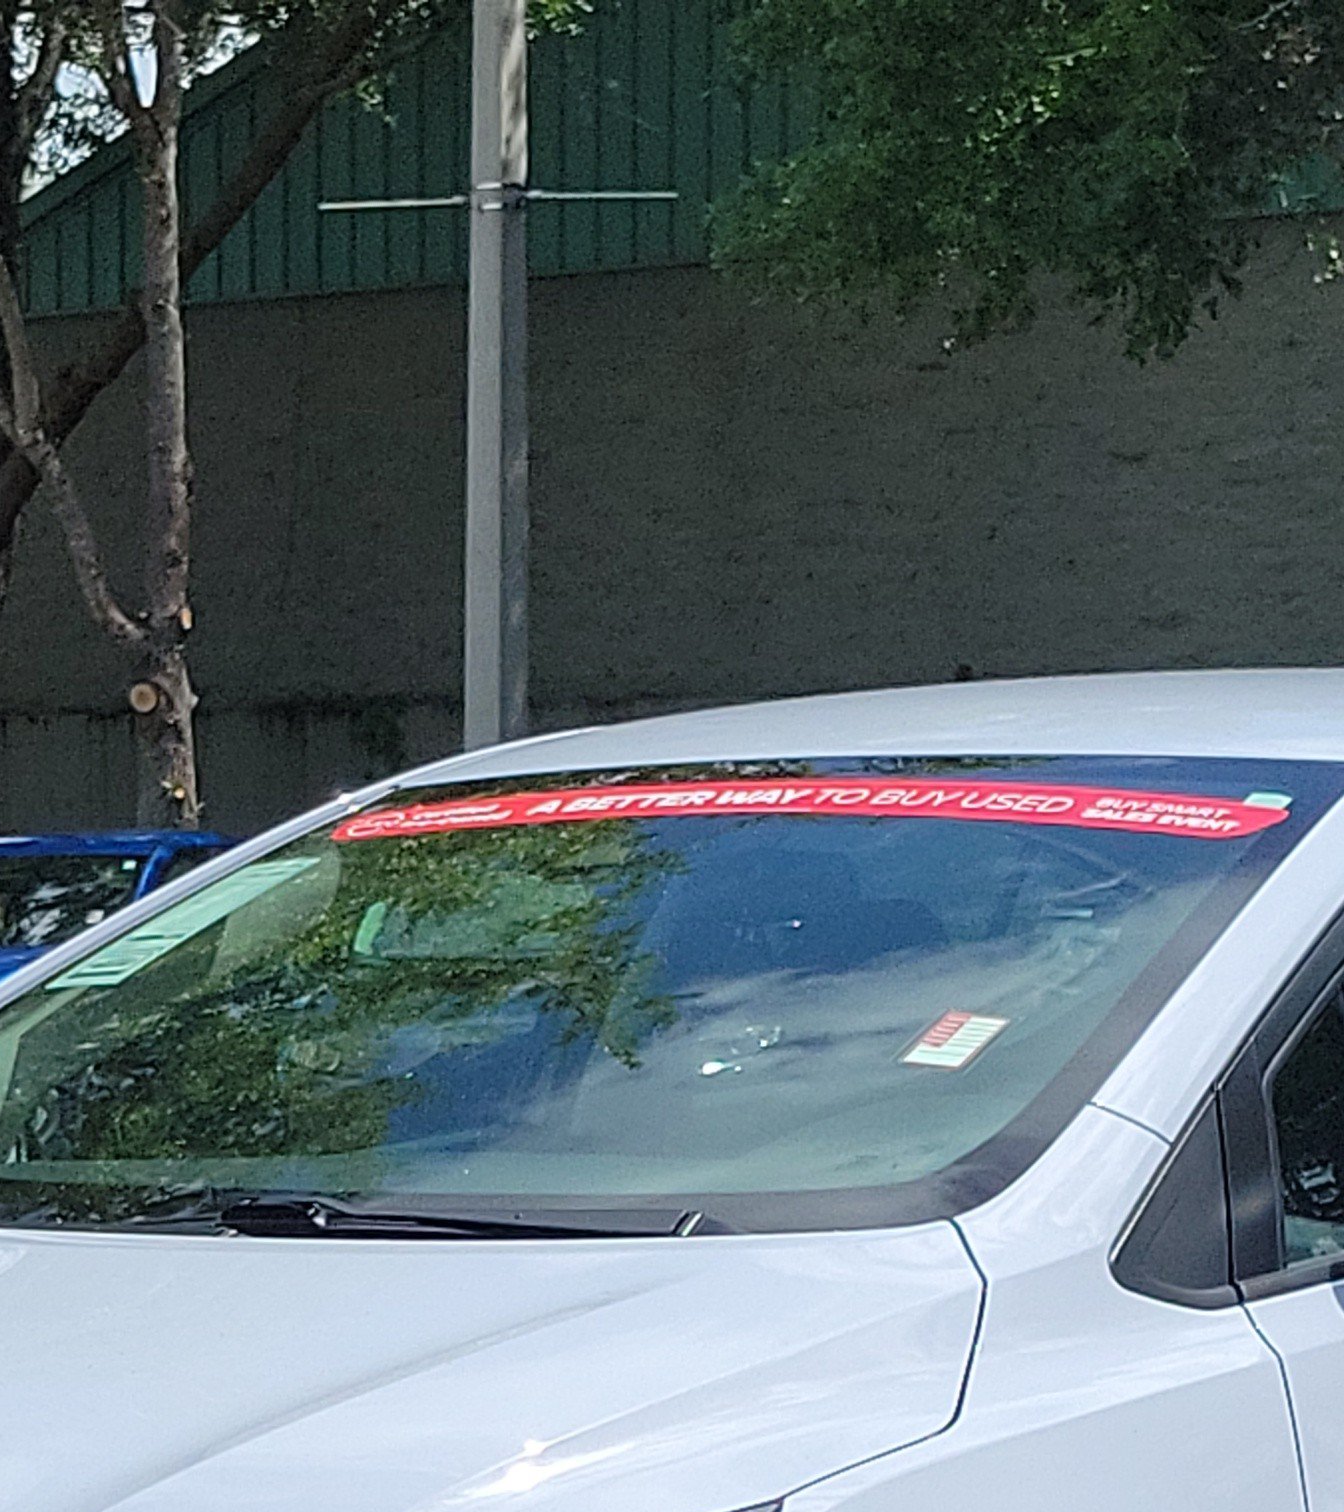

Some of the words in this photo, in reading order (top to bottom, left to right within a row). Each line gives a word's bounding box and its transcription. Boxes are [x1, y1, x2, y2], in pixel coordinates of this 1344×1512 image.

[526, 799, 561, 816] A
[560, 791, 716, 812] BETTER
[714, 789, 812, 805] WAY
[813, 788, 870, 805] TO
[869, 789, 961, 807] BUY
[960, 791, 1075, 813] USED
[1095, 797, 1149, 811] BUY
[1145, 802, 1233, 819] SMART
[1080, 808, 1159, 823] SALES
[1156, 814, 1242, 832] EVENT
